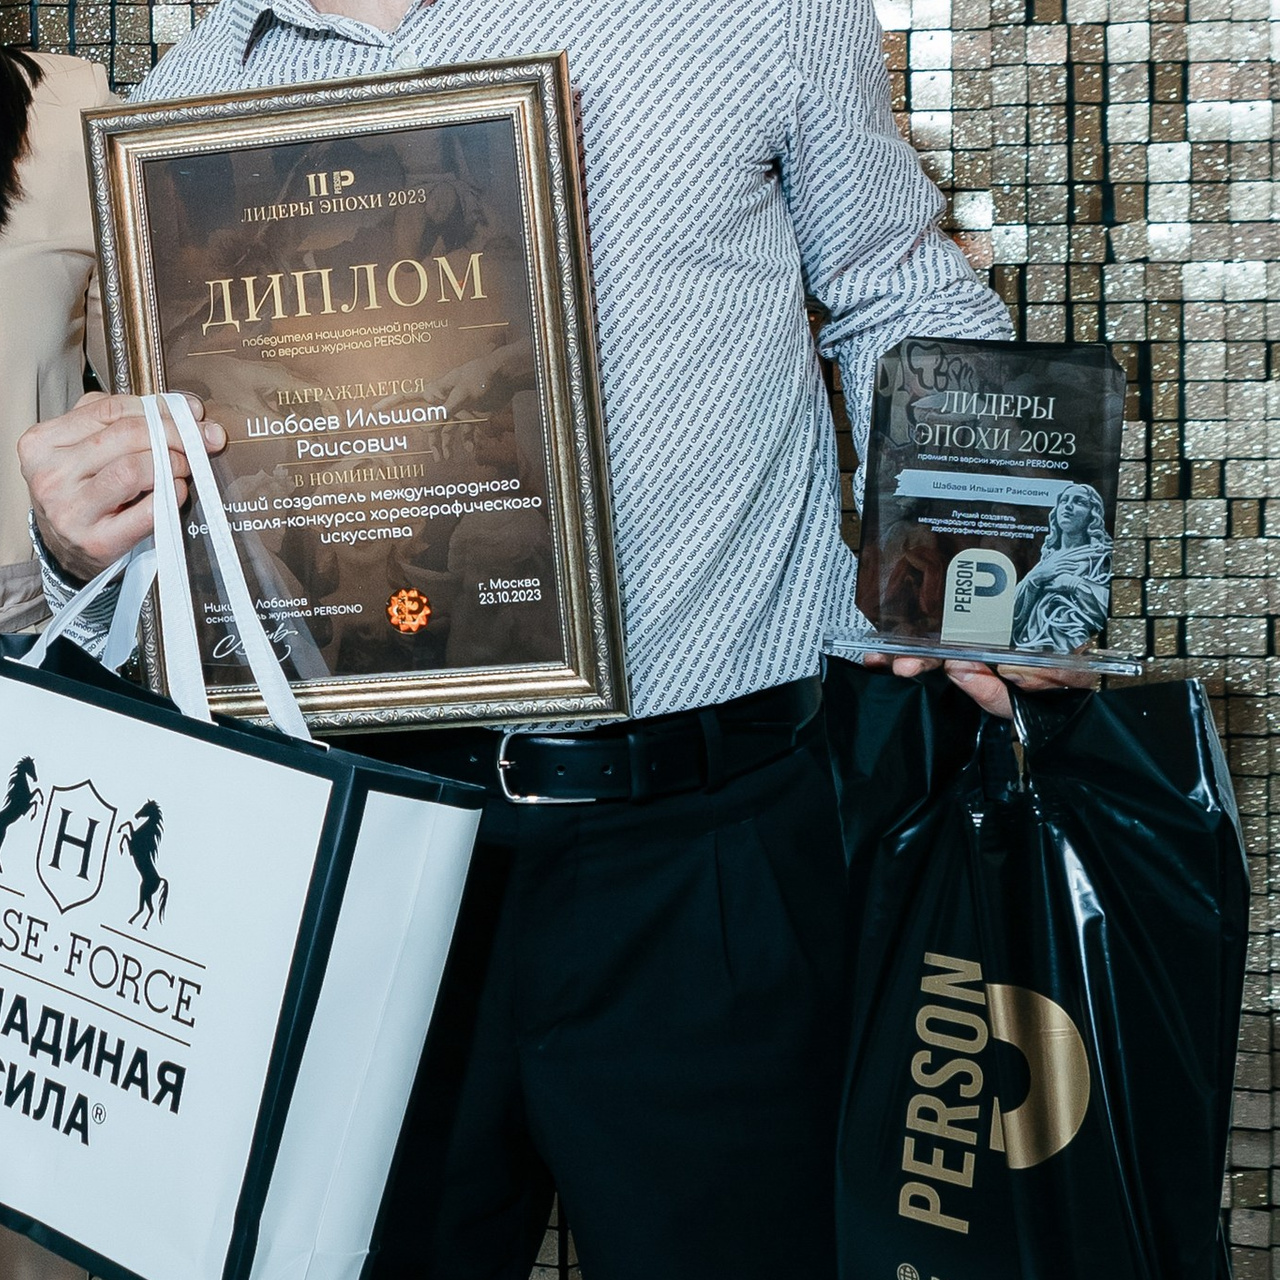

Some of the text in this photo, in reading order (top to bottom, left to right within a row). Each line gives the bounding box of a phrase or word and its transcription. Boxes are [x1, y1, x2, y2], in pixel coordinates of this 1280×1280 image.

[240, 188, 426, 224] ЛИДЕРЫ ЭПОХИ 2023
[198, 251, 488, 336] ДИПЛОМ
[241, 318, 448, 348] победителя национальной премии
[261, 332, 431, 358] по версии журнала PERSONO
[277, 378, 425, 406] НАГРАЖДАЕТСЯ
[940, 390, 1055, 421] ЛИДЕРЫ
[246, 401, 447, 437] Шабаев Ильшат
[296, 431, 407, 458] Раисович
[913, 422, 1076, 455] ЭПОХИ 2023
[293, 463, 425, 487] В НОМИНАЦИИ
[1025, 459, 1069, 469] PERSONO
[222, 477, 520, 514] чший создатель международного
[932, 481, 1048, 496] Шабаев Ильшат Раисович
[369, 495, 542, 524] хореографического
[320, 525, 412, 545] искусства
[478, 576, 540, 590] г. Москва
[479, 588, 541, 605] 23.10.2023
[255, 596, 308, 609] Лобанов
[268, 609, 311, 621] журнала
[313, 604, 362, 616] PERSONO
[48, 806, 100, 881] H
[62, 931, 202, 1028] FORCE
[897, 950, 991, 1235] PERSON
